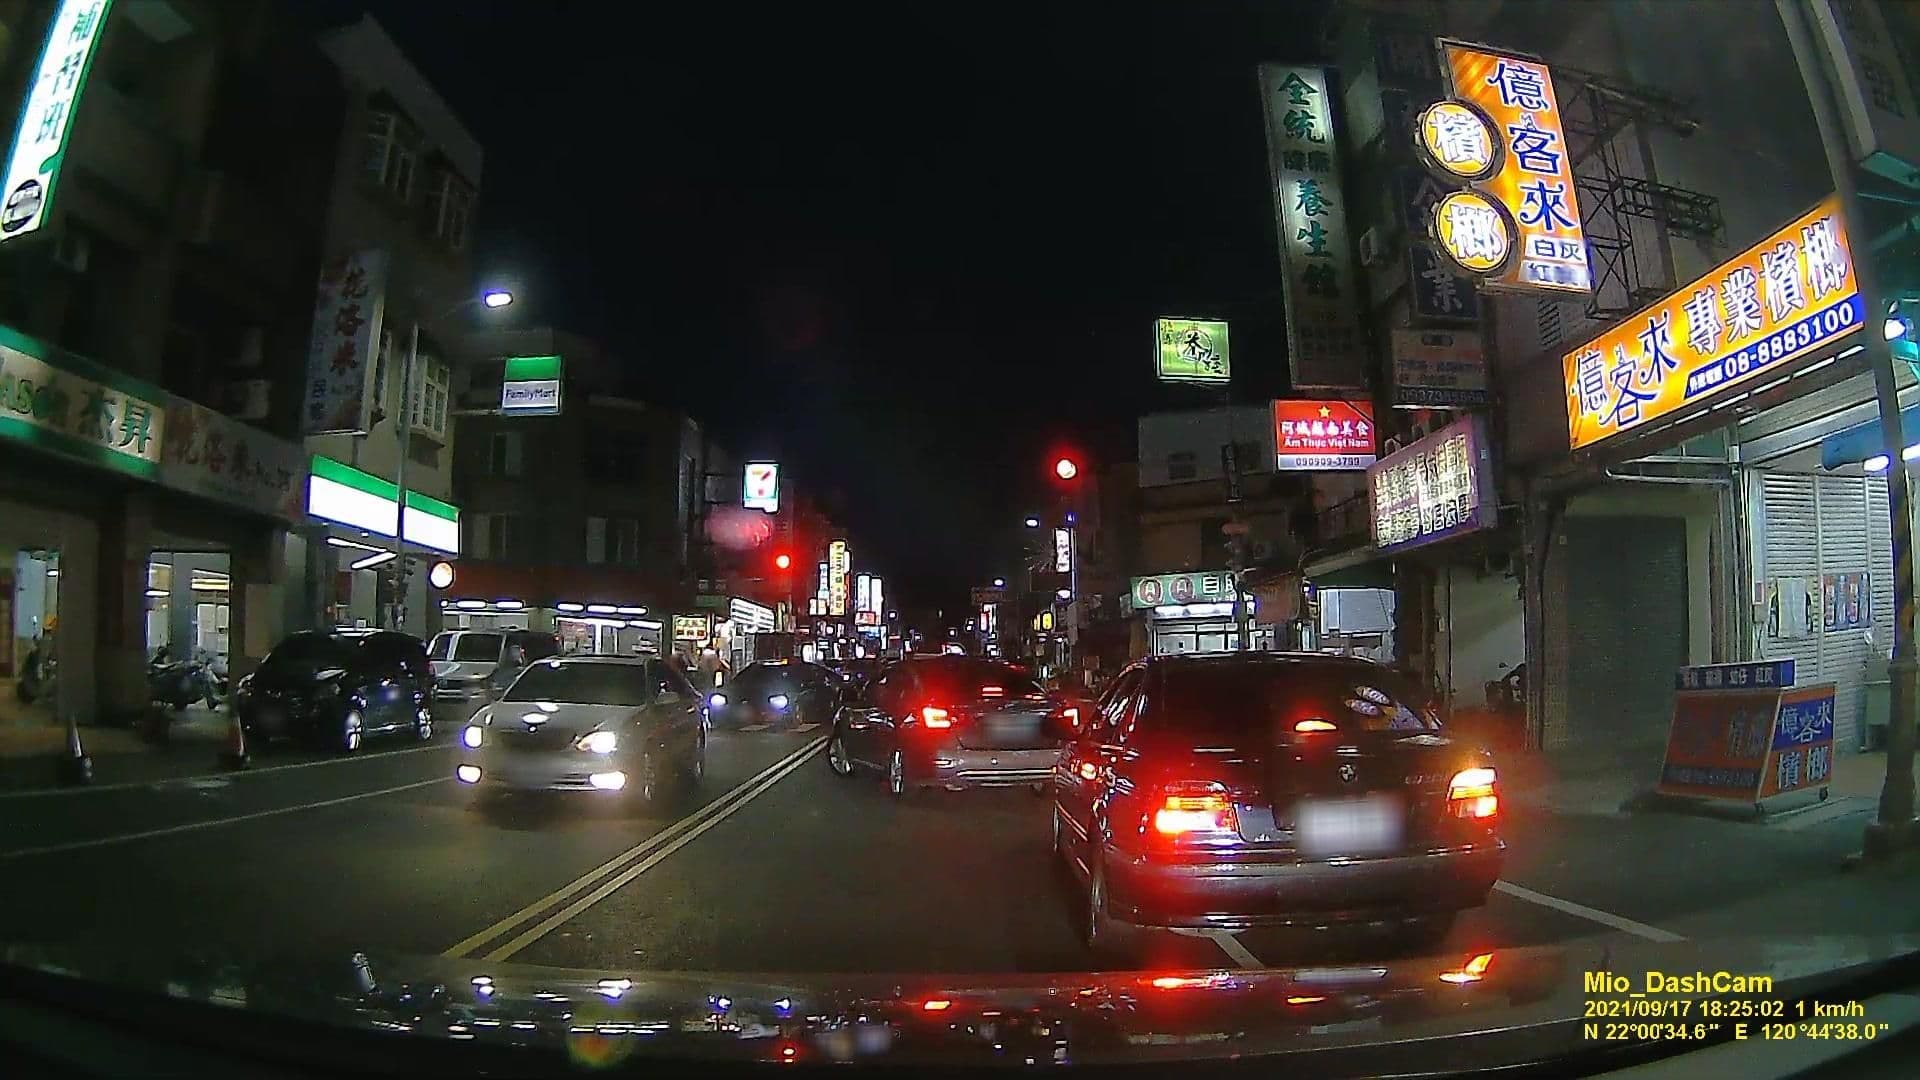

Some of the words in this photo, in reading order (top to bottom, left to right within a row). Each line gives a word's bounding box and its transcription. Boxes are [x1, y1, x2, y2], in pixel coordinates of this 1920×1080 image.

[1487, 61, 1579, 232] 億客來
[1534, 238, 1582, 261] 白灰
[1575, 310, 1681, 427] 億客來
[1683, 215, 1848, 356] 專業檳榔
[1724, 301, 1854, 378] 08-8883100
[505, 388, 556, 401] FamilyMart
[1775, 700, 1833, 744] 億客來
